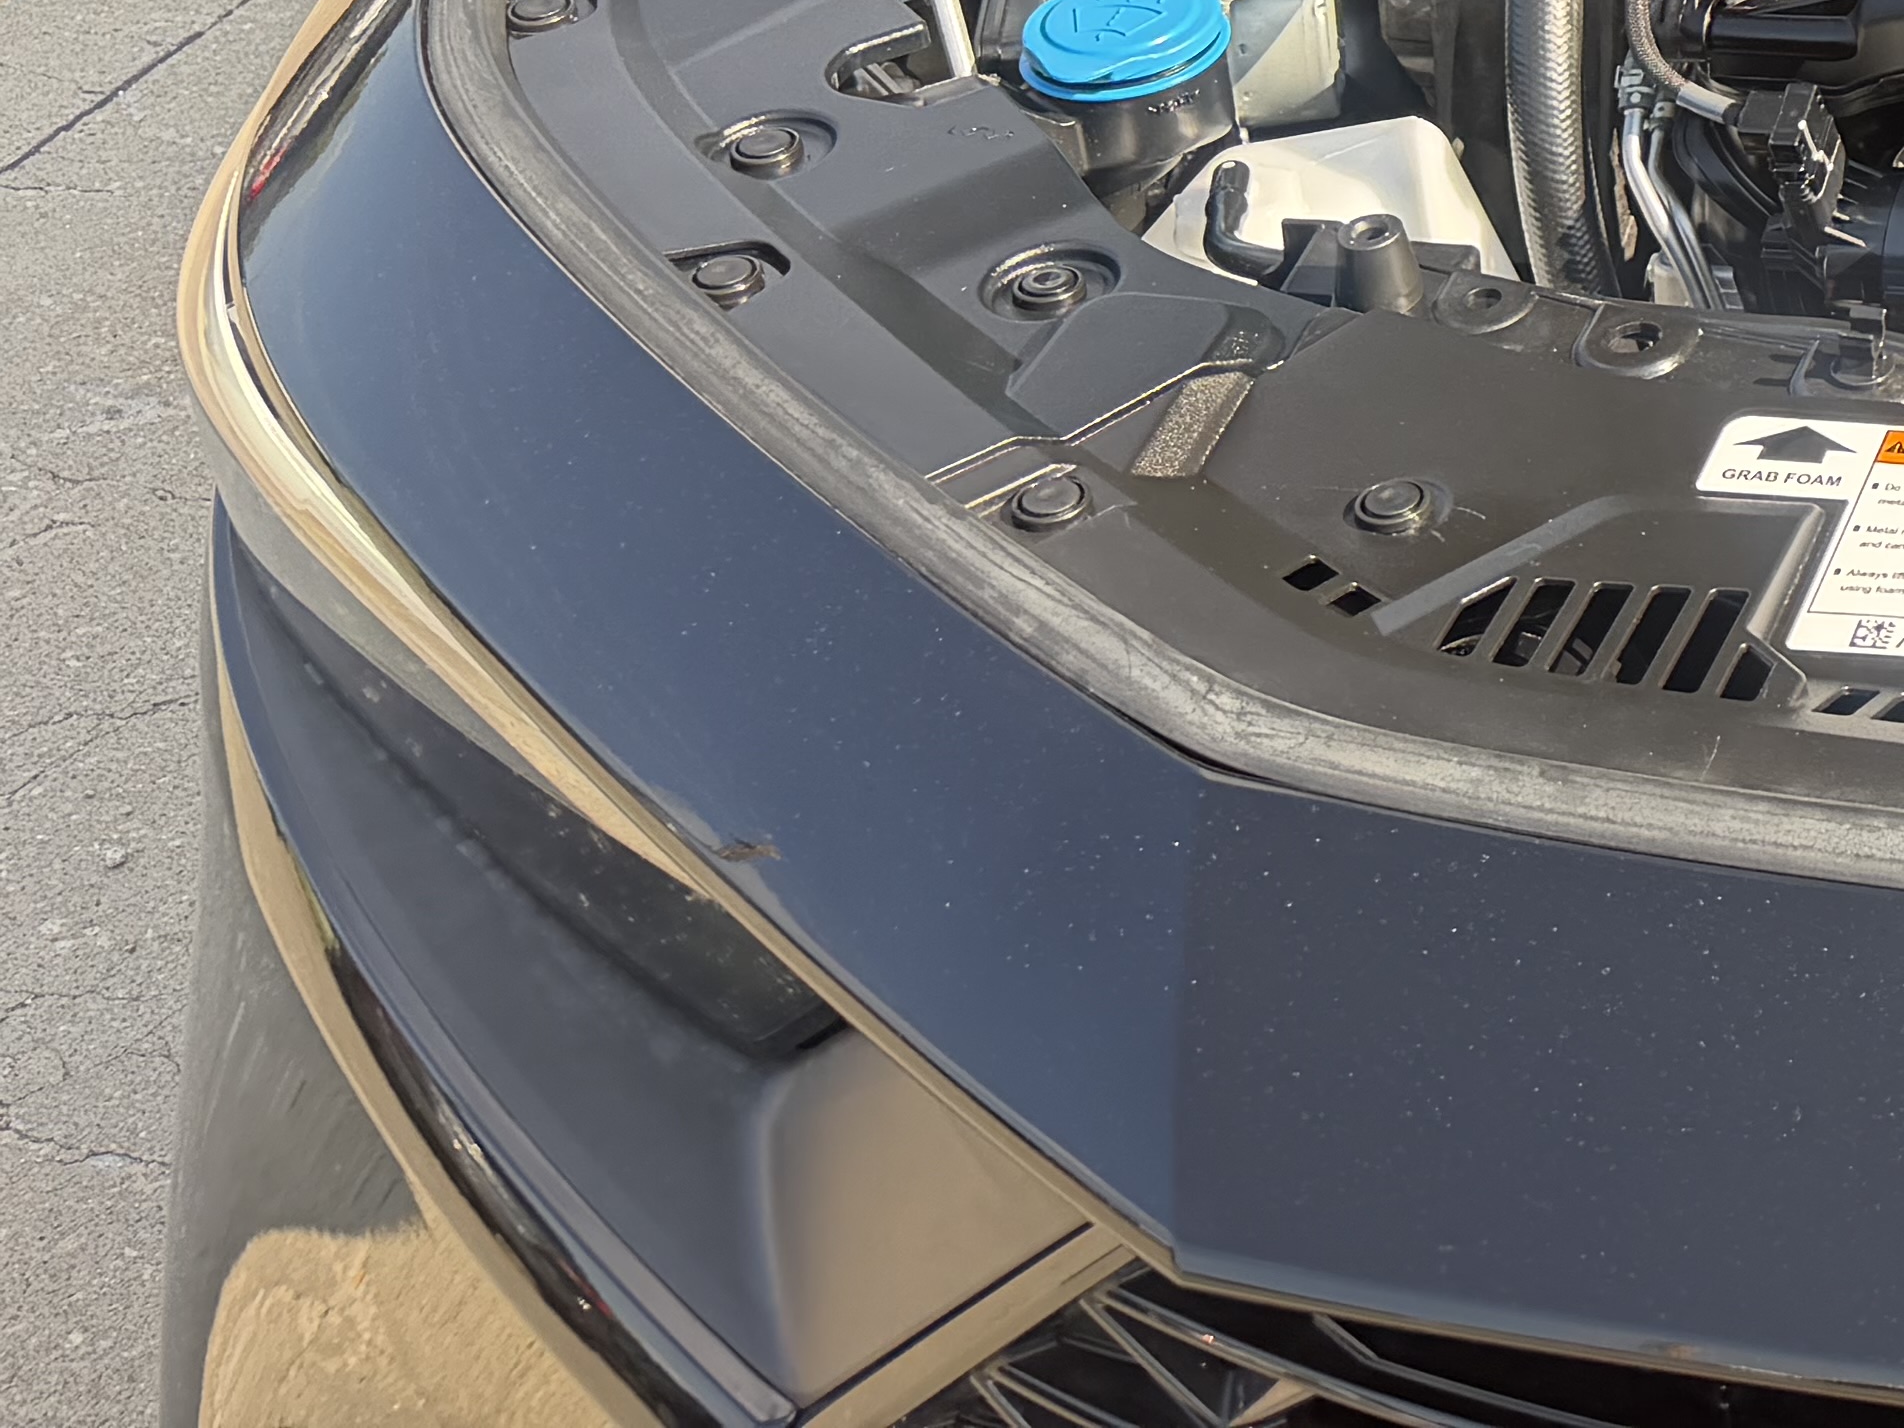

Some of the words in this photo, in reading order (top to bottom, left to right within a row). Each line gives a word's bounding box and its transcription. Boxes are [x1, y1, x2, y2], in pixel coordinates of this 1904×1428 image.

[1721, 468, 1778, 483] GRAB
[1783, 472, 1843, 487] FOAM
[1885, 483, 1900, 491] Do
[1866, 525, 1898, 535] Metal
[1846, 569, 1888, 580] Always
[1840, 585, 1872, 594] using
[1875, 586, 1904, 594] foam
